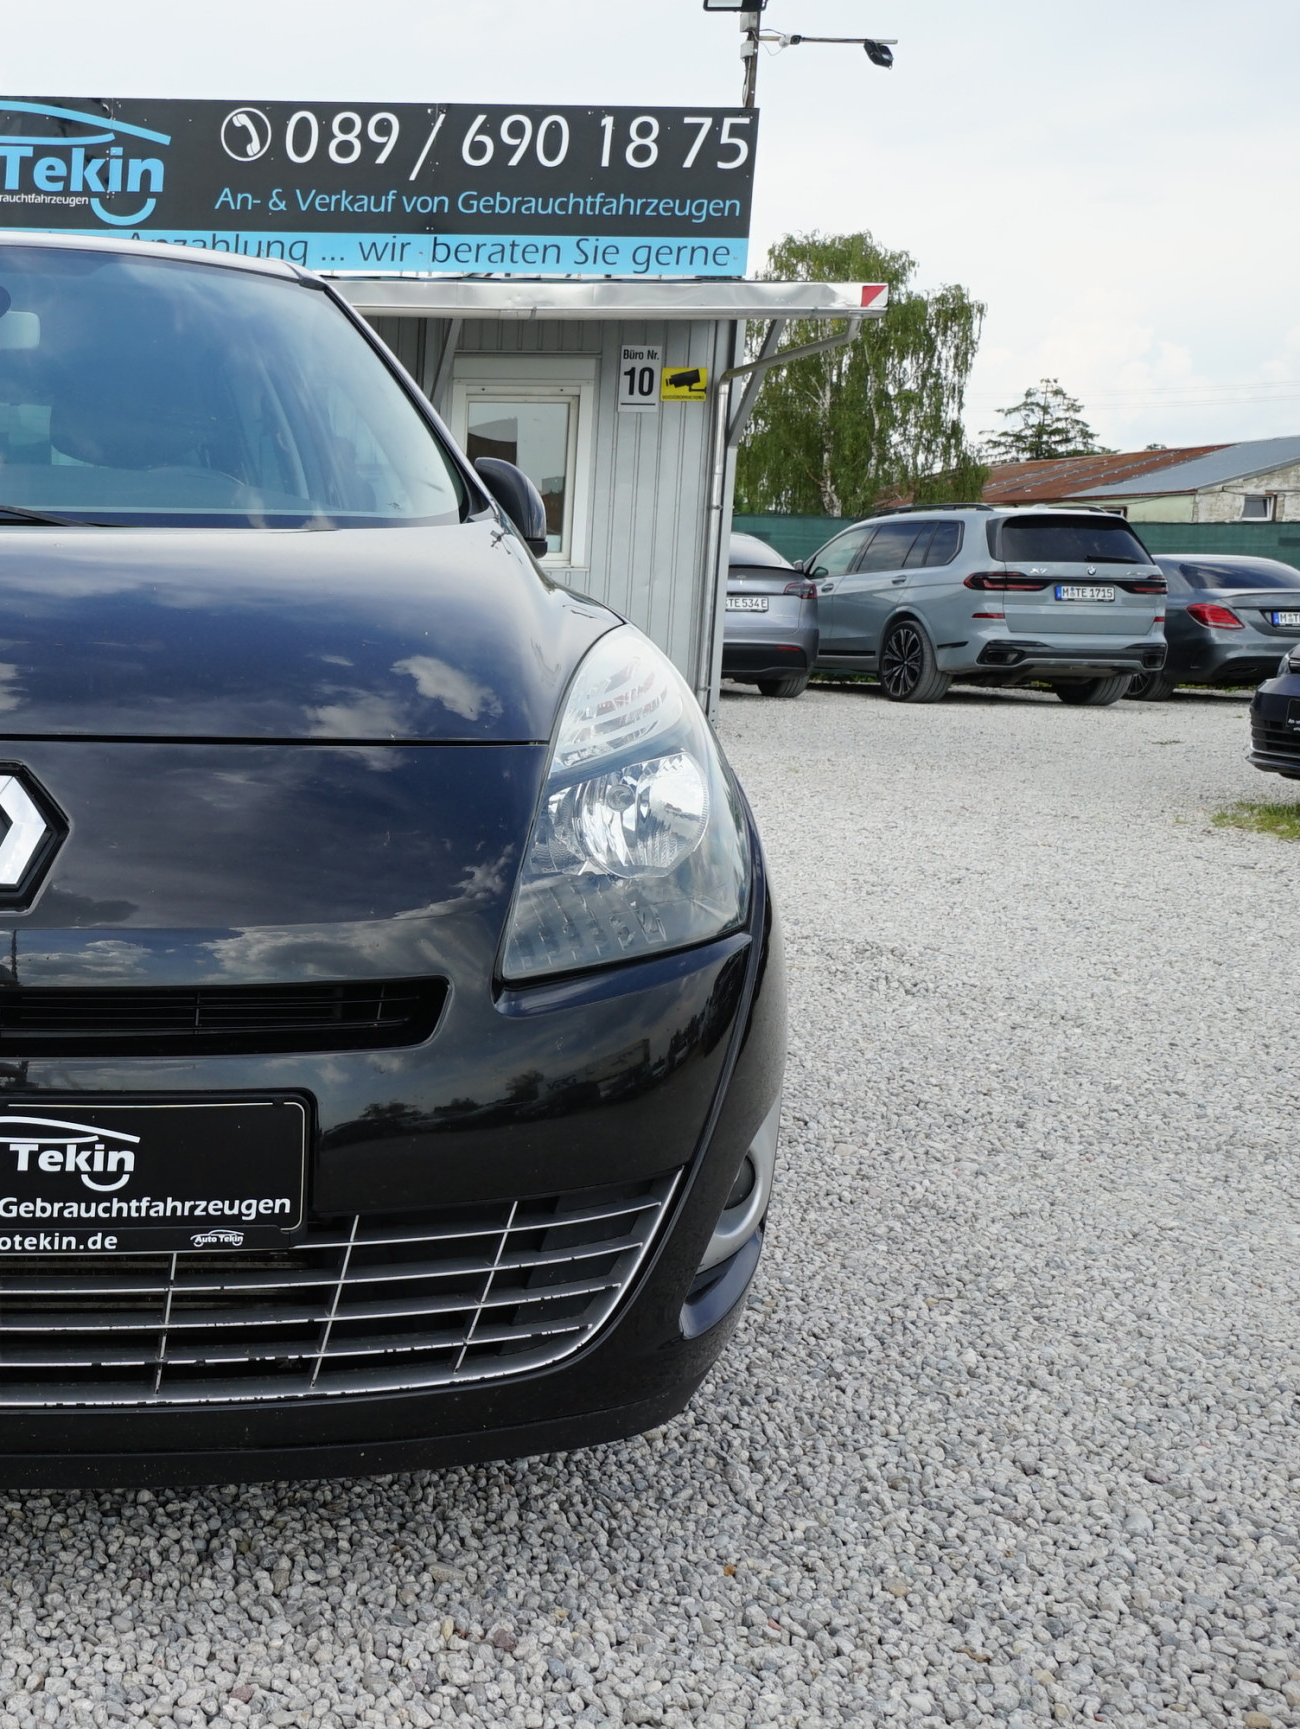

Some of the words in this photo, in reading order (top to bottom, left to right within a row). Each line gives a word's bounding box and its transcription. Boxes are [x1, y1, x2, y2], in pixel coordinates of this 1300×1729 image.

[285, 110, 400, 164] 089
[461, 114, 570, 167] 690
[600, 115, 660, 169] 18
[682, 116, 750, 169] 75
[213, 186, 261, 210] An-
[268, 188, 287, 211] &
[295, 189, 397, 213] Verkauf
[402, 195, 449, 214] von
[457, 191, 741, 223] Gebrauchtfahrzeugen
[358, 235, 411, 263] wir
[430, 236, 561, 264] beraten
[573, 237, 620, 266] Sie
[631, 243, 731, 275] gerne
[623, 348, 644, 360] Büro
[647, 349, 660, 360] Nr.
[624, 367, 654, 396] 10
[1089, 589, 1114, 598] 1715
[8, 1143, 135, 1172] Tekin
[194, 1234, 217, 1243] Auto
[218, 1233, 243, 1243] Tekin
